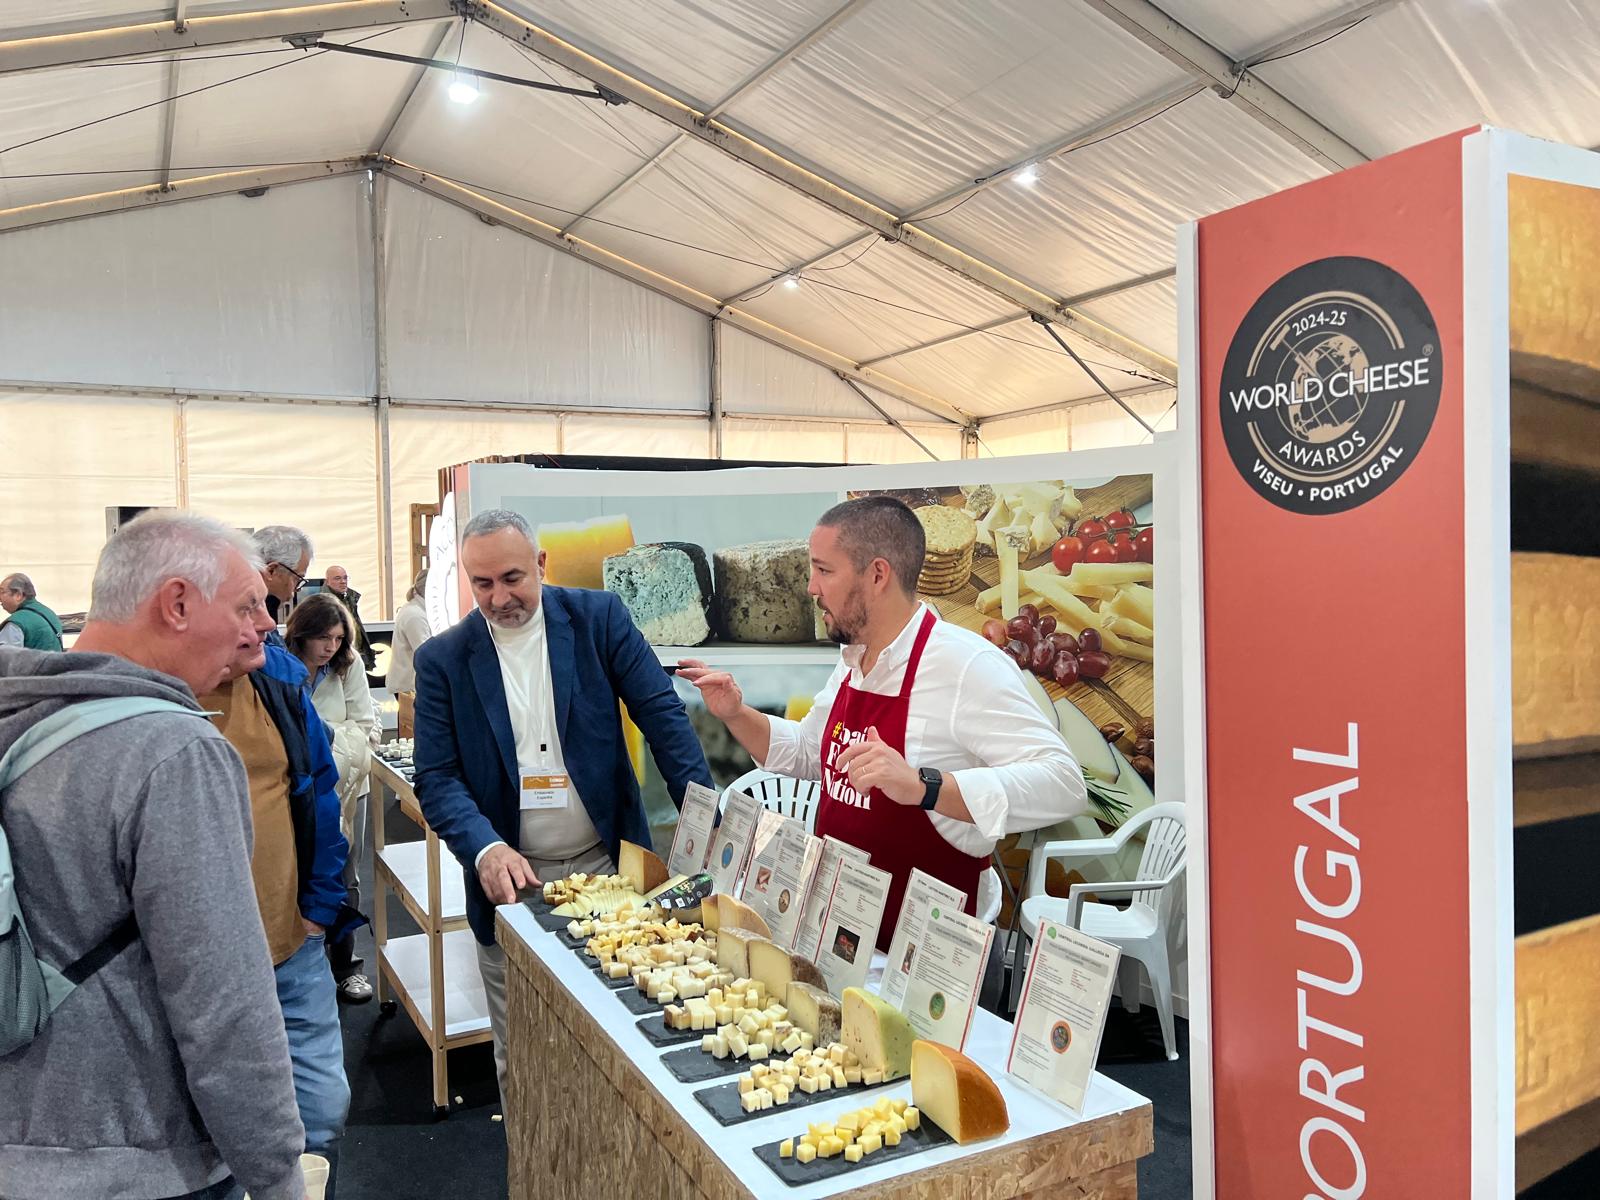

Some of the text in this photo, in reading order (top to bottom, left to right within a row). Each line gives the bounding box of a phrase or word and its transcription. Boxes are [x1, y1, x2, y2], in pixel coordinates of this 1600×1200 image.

[1292, 310, 1347, 337] 2024-25
[1229, 358, 1429, 413] WORLD CHEESE
[1252, 445, 1404, 501] VISEU PORTUGAL
[1279, 430, 1366, 467] AWARDS
[1293, 722, 1367, 1200] ORTUGAL
